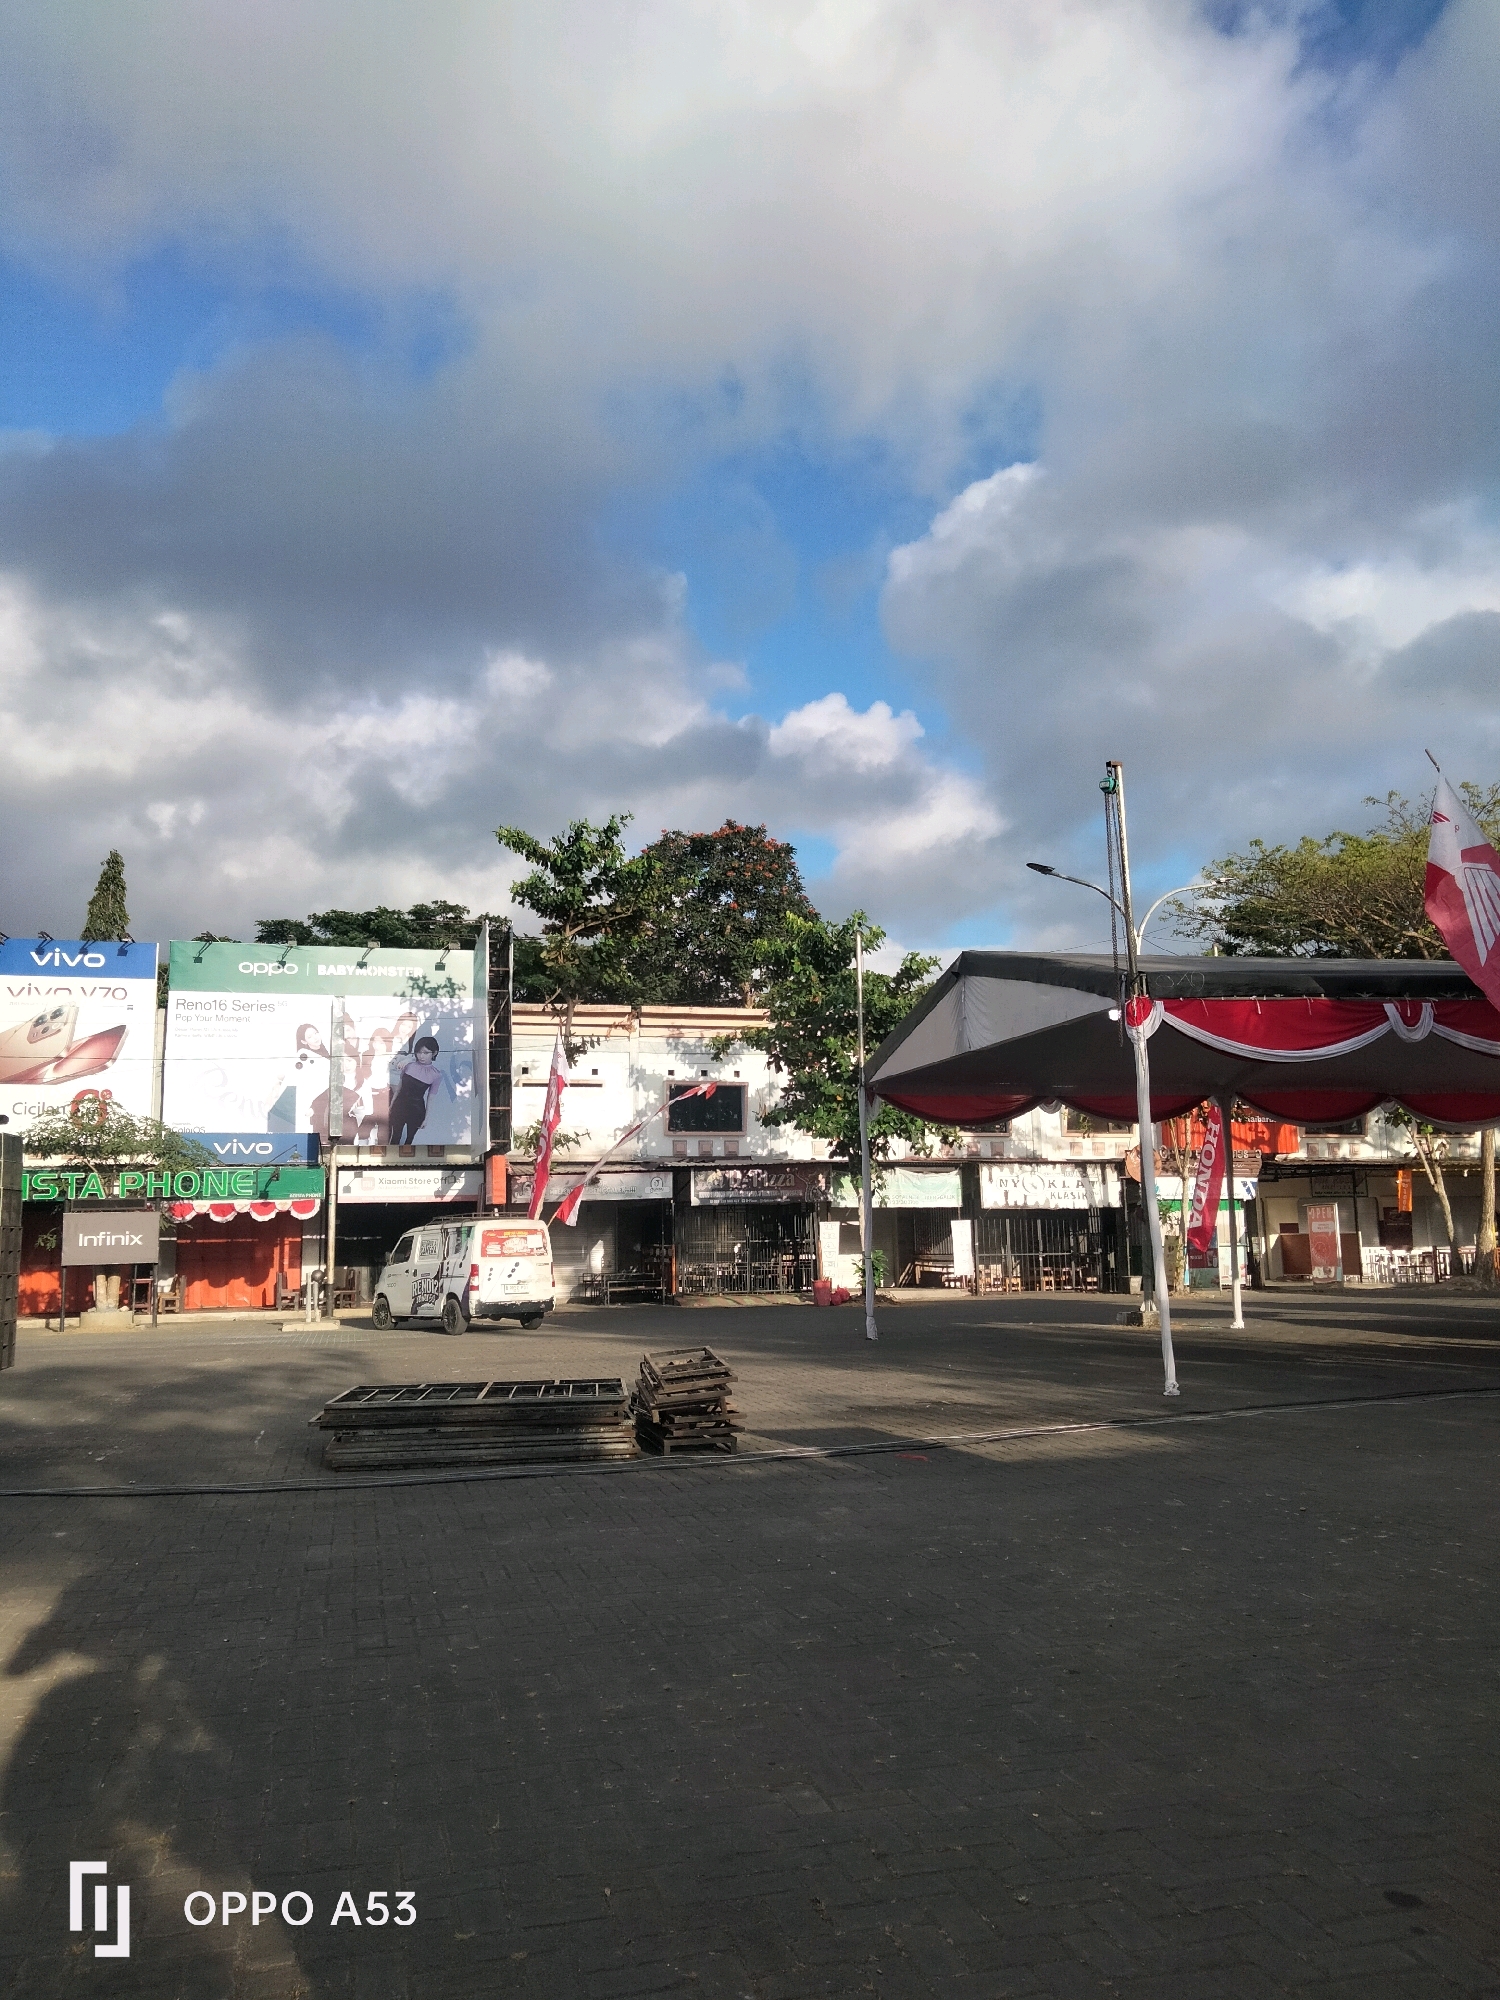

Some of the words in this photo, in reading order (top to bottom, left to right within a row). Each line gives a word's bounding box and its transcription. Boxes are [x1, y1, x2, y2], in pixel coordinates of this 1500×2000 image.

[30, 947, 106, 968] vivo
[238, 962, 299, 976] oppo
[318, 964, 424, 978] BABYMONSTER
[7, 983, 73, 998] vivo
[80, 986, 128, 1001] V70
[175, 999, 228, 1012] Reno16
[231, 999, 276, 1013] Series
[175, 1013, 193, 1023] Pop
[194, 1014, 213, 1022] Your
[215, 1015, 251, 1023] Moment
[213, 1138, 274, 1155] vivo
[1188, 1118, 1222, 1228] HONDA
[119, 1170, 254, 1200] PHONE
[378, 1177, 407, 1186] Xiaomi
[408, 1177, 431, 1185] Store
[78, 1231, 143, 1247] Infinix
